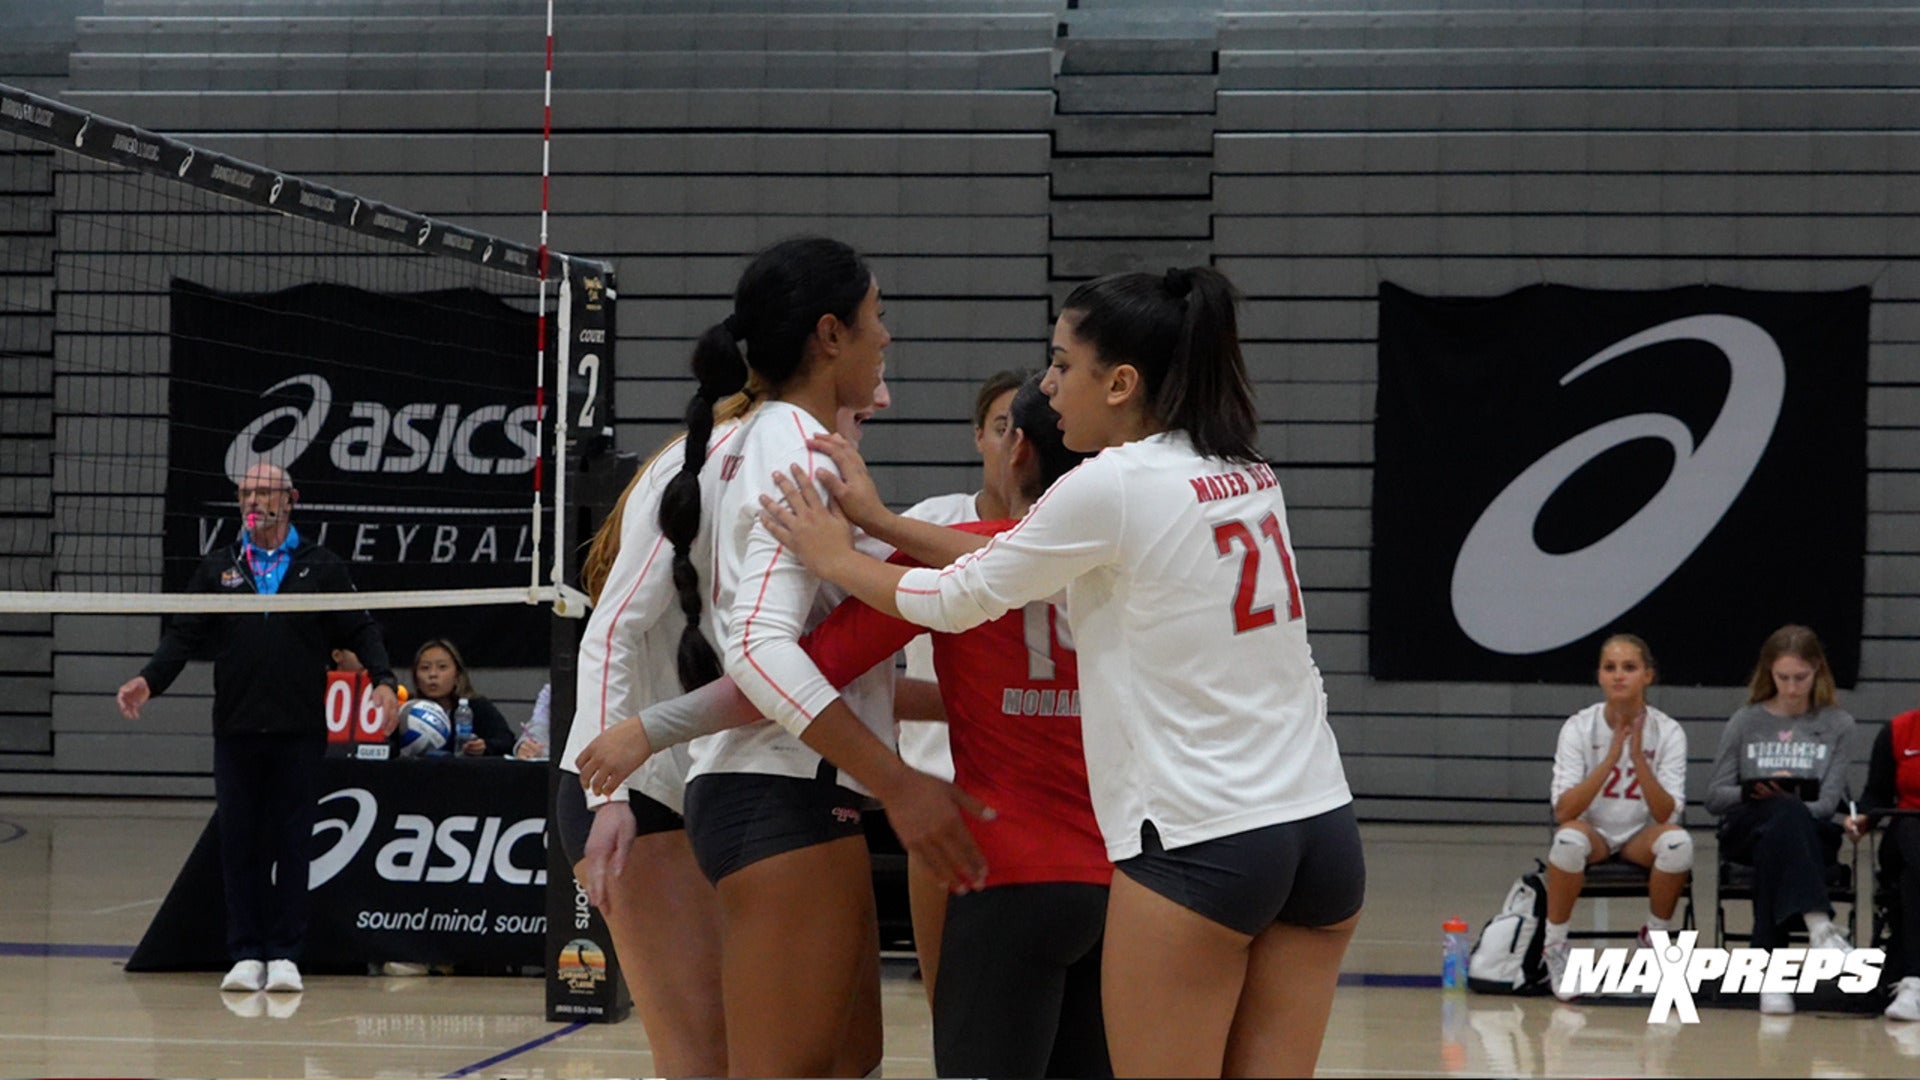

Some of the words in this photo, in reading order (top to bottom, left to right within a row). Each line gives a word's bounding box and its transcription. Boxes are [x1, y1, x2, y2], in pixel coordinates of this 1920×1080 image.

[578, 353, 600, 427] 2
[1189, 471, 1250, 503] MATER
[1211, 510, 1303, 636] 21
[325, 680, 384, 734] 06
[1603, 766, 1642, 800] 22
[356, 908, 429, 930] sound
[430, 908, 488, 935] mind,
